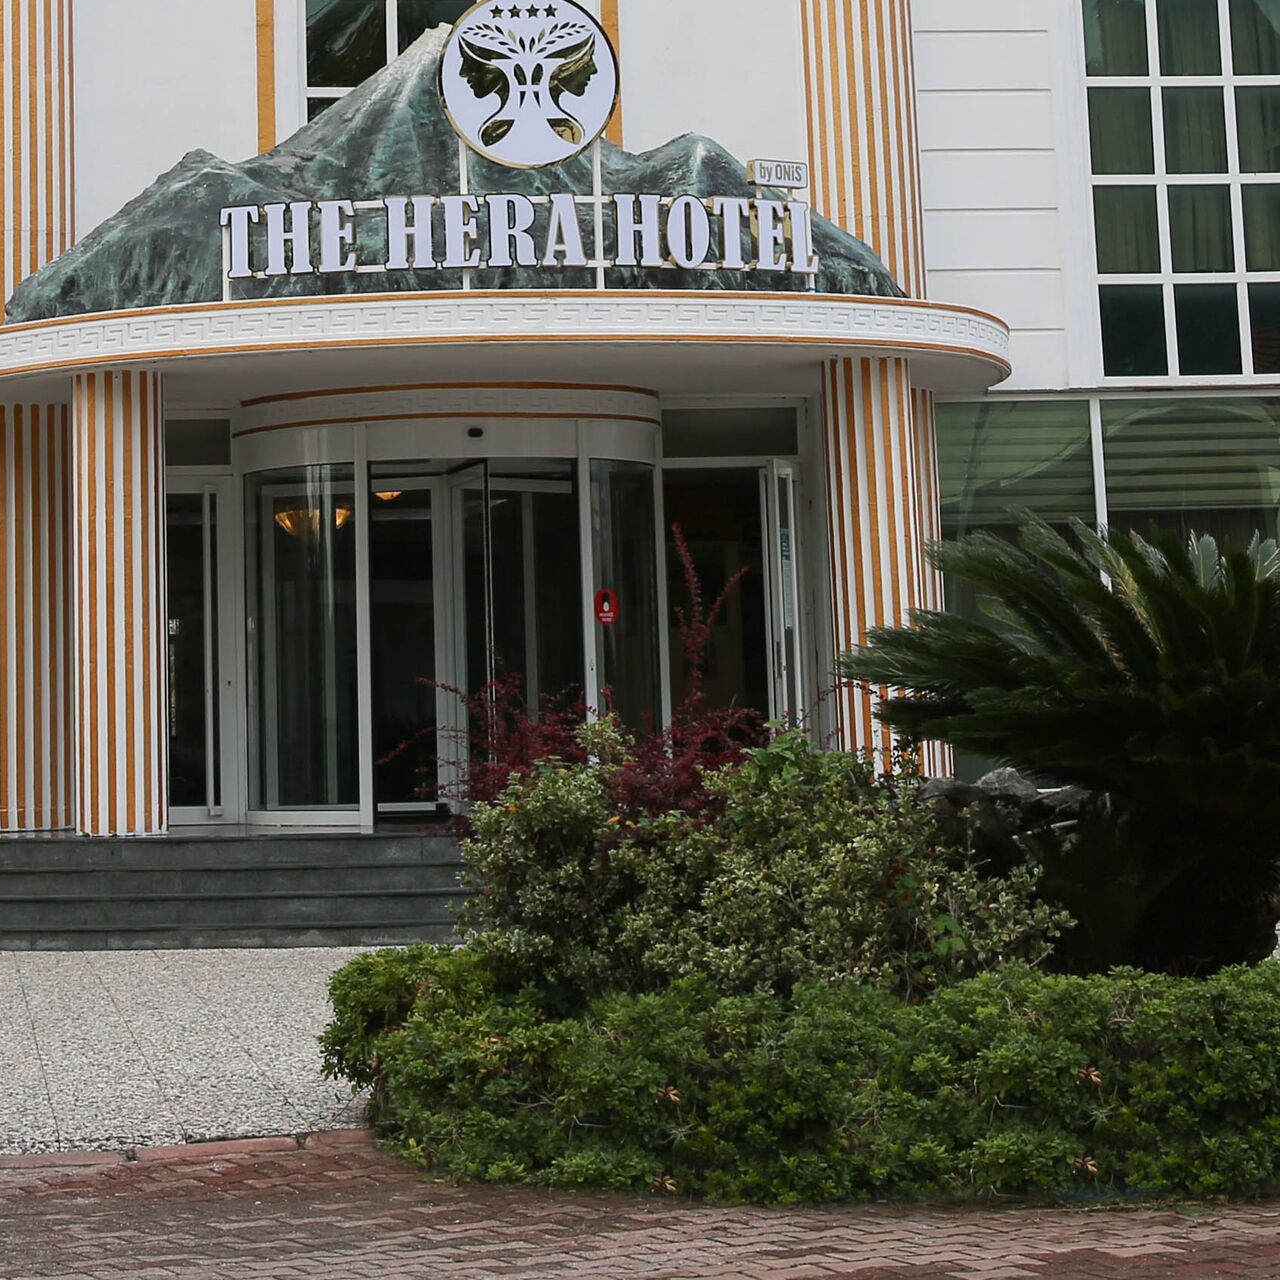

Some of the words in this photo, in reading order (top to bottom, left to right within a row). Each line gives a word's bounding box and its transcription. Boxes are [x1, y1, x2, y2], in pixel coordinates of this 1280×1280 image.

[759, 161, 773, 183] by
[220, 199, 357, 279] THE
[383, 193, 588, 270] HERA
[612, 193, 819, 274] HOTEL
